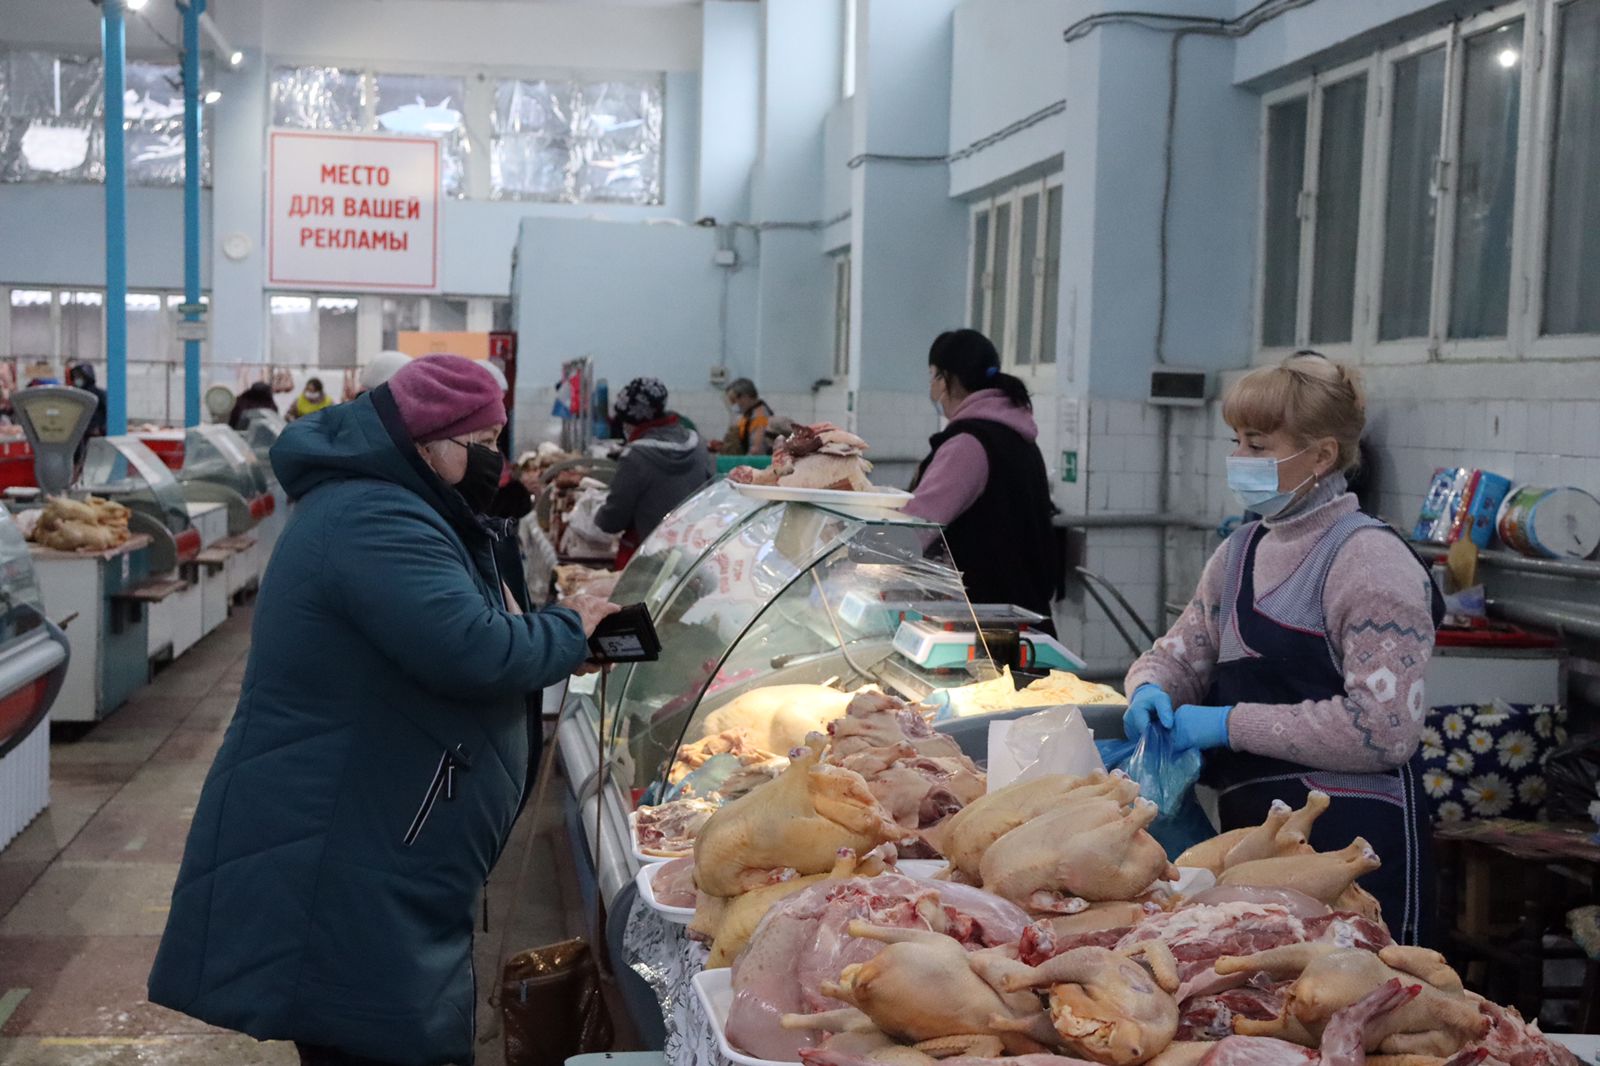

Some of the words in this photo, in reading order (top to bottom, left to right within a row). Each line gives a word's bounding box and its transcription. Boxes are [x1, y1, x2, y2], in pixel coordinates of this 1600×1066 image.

[320, 164, 390, 187] МЕСТО
[289, 194, 335, 218] ДЛЯ
[343, 196, 420, 220] ВАШЕЙ
[300, 228, 409, 251] РЕКЛАМЫ
